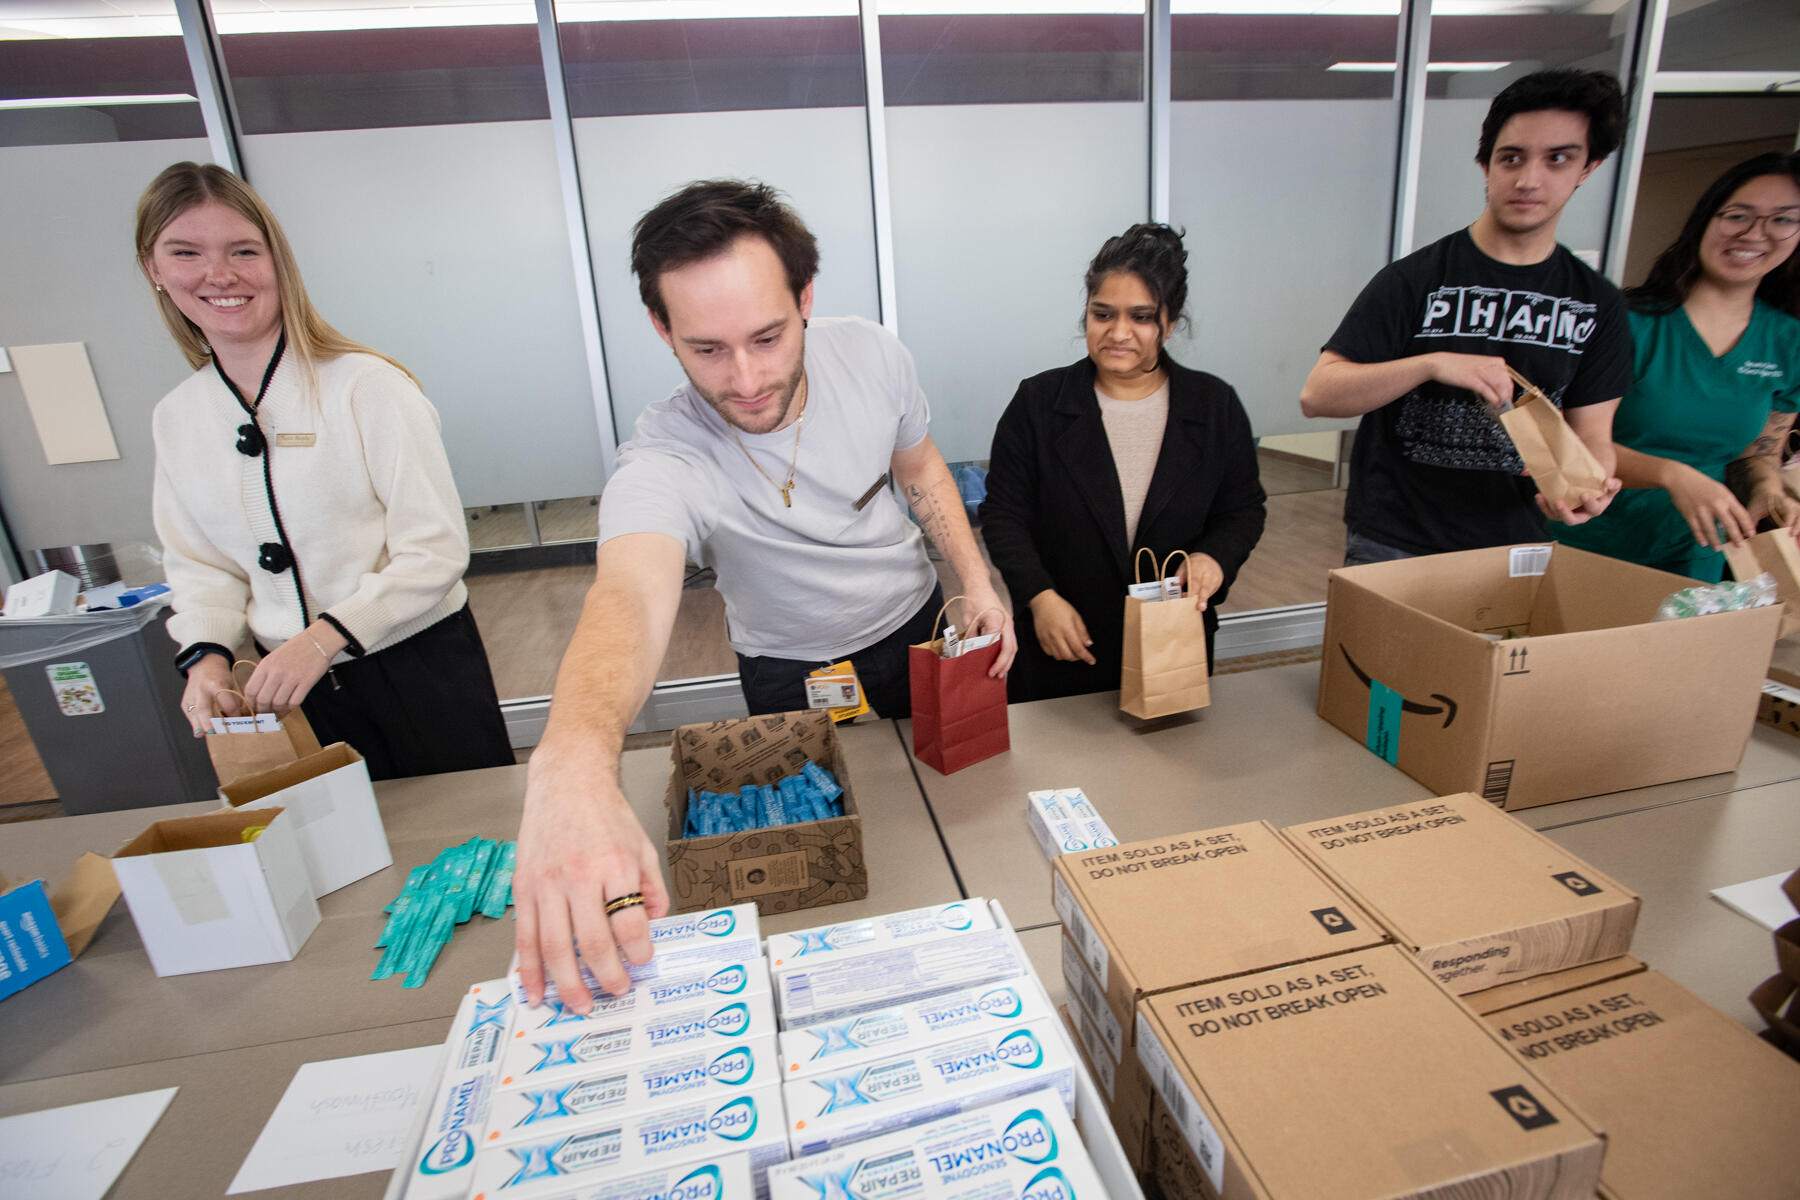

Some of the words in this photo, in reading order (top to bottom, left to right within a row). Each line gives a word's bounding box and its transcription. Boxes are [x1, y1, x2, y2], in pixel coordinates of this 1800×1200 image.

[1307, 824, 1346, 839] ITEM
[1345, 817, 1387, 831] SOLD
[1388, 812, 1409, 823] AS
[1320, 839, 1345, 850] DO
[1344, 832, 1377, 845] NOT
[1375, 822, 1428, 839] BREAK
[1425, 814, 1467, 829] OPEN
[1081, 852, 1120, 868] ITEM
[1123, 845, 1165, 861] SOLD
[1169, 841, 1191, 854] AS
[1088, 866, 1114, 881] DO
[1117, 860, 1149, 876] NOT
[1150, 852, 1203, 870] BREAK
[1204, 843, 1249, 860] OPEN
[653, 917, 729, 939] PRONAME
[1432, 945, 1511, 970] Responding
[650, 973, 741, 1002] PRONAMEL
[1176, 996, 1226, 1018] ITEM
[1231, 984, 1283, 1006] SOLD
[1286, 978, 1313, 996] AS
[1316, 974, 1332, 989] A
[1334, 964, 1375, 983] SET,
[920, 993, 1013, 1024] PRONAMEL
[1189, 1018, 1221, 1038] DO
[1222, 1006, 1264, 1030] NOT
[1265, 995, 1334, 1022] BREAK
[1333, 982, 1387, 1006] OPEN
[1512, 1015, 1564, 1037] SOLD
[1563, 1007, 1590, 1024] AS
[1588, 1004, 1607, 1016] A
[646, 1012, 742, 1041] PRONAMEL
[1517, 1040, 1558, 1060] NOT
[1553, 1024, 1618, 1051] BREAK
[1613, 1010, 1665, 1033] OPEN
[578, 1036, 633, 1056] REPAIR
[934, 1042, 1032, 1076] PRONAMEL
[643, 1058, 746, 1091] PRONAMEL
[866, 1072, 921, 1094] REPAIR
[570, 1085, 628, 1107] REPAIR
[439, 1078, 477, 1166] PRONAMEL
[639, 1109, 749, 1147] PRONAMEL
[561, 1141, 623, 1166] REPAIR
[645, 1133, 708, 1157] SENSODYNE
[928, 1126, 1046, 1173] PRONAMEL
[859, 1166, 922, 1194] REPAIR
[942, 1158, 1008, 1185] SENSODYNE
